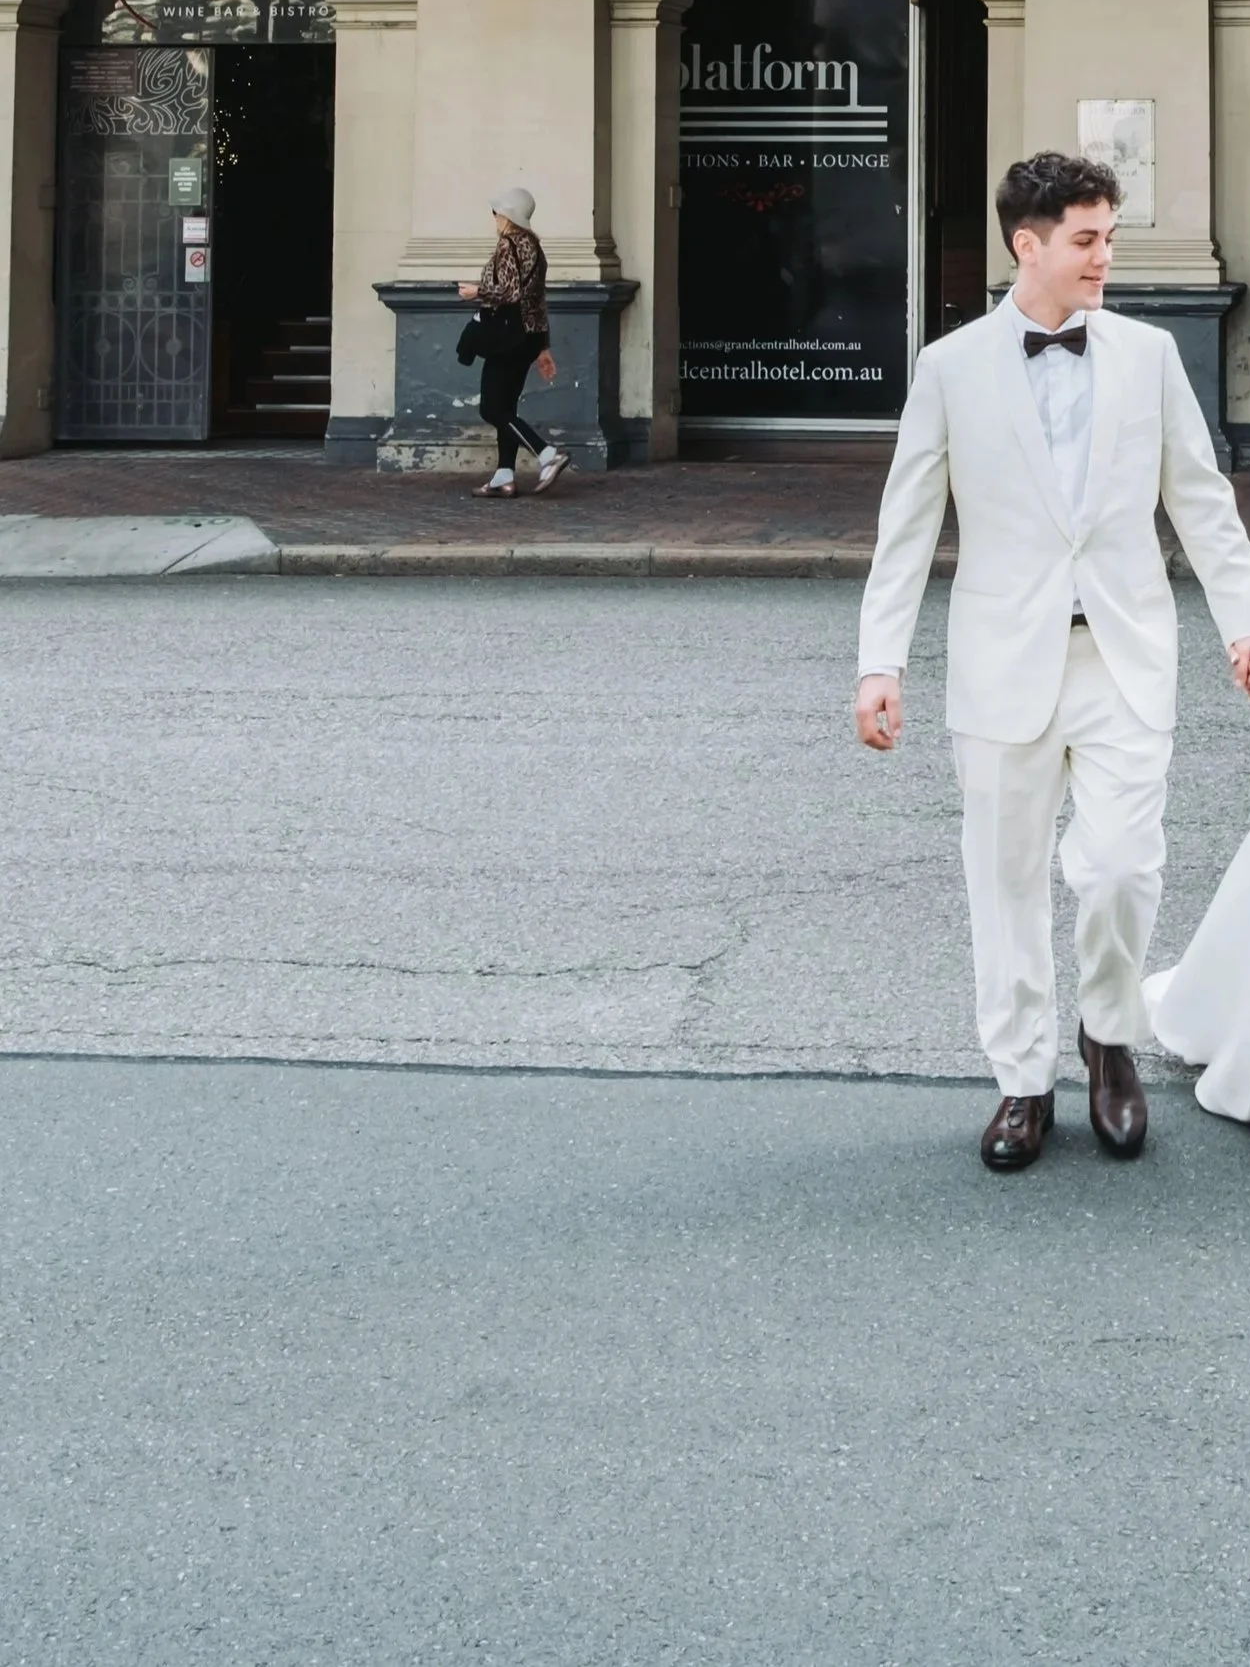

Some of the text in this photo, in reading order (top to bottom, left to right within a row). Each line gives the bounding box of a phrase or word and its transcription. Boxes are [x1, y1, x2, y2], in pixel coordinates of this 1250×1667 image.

[163, 5, 329, 17] WINE BAR & BISTRO
[680, 153, 890, 168] TIONS BAR LOUNGE
